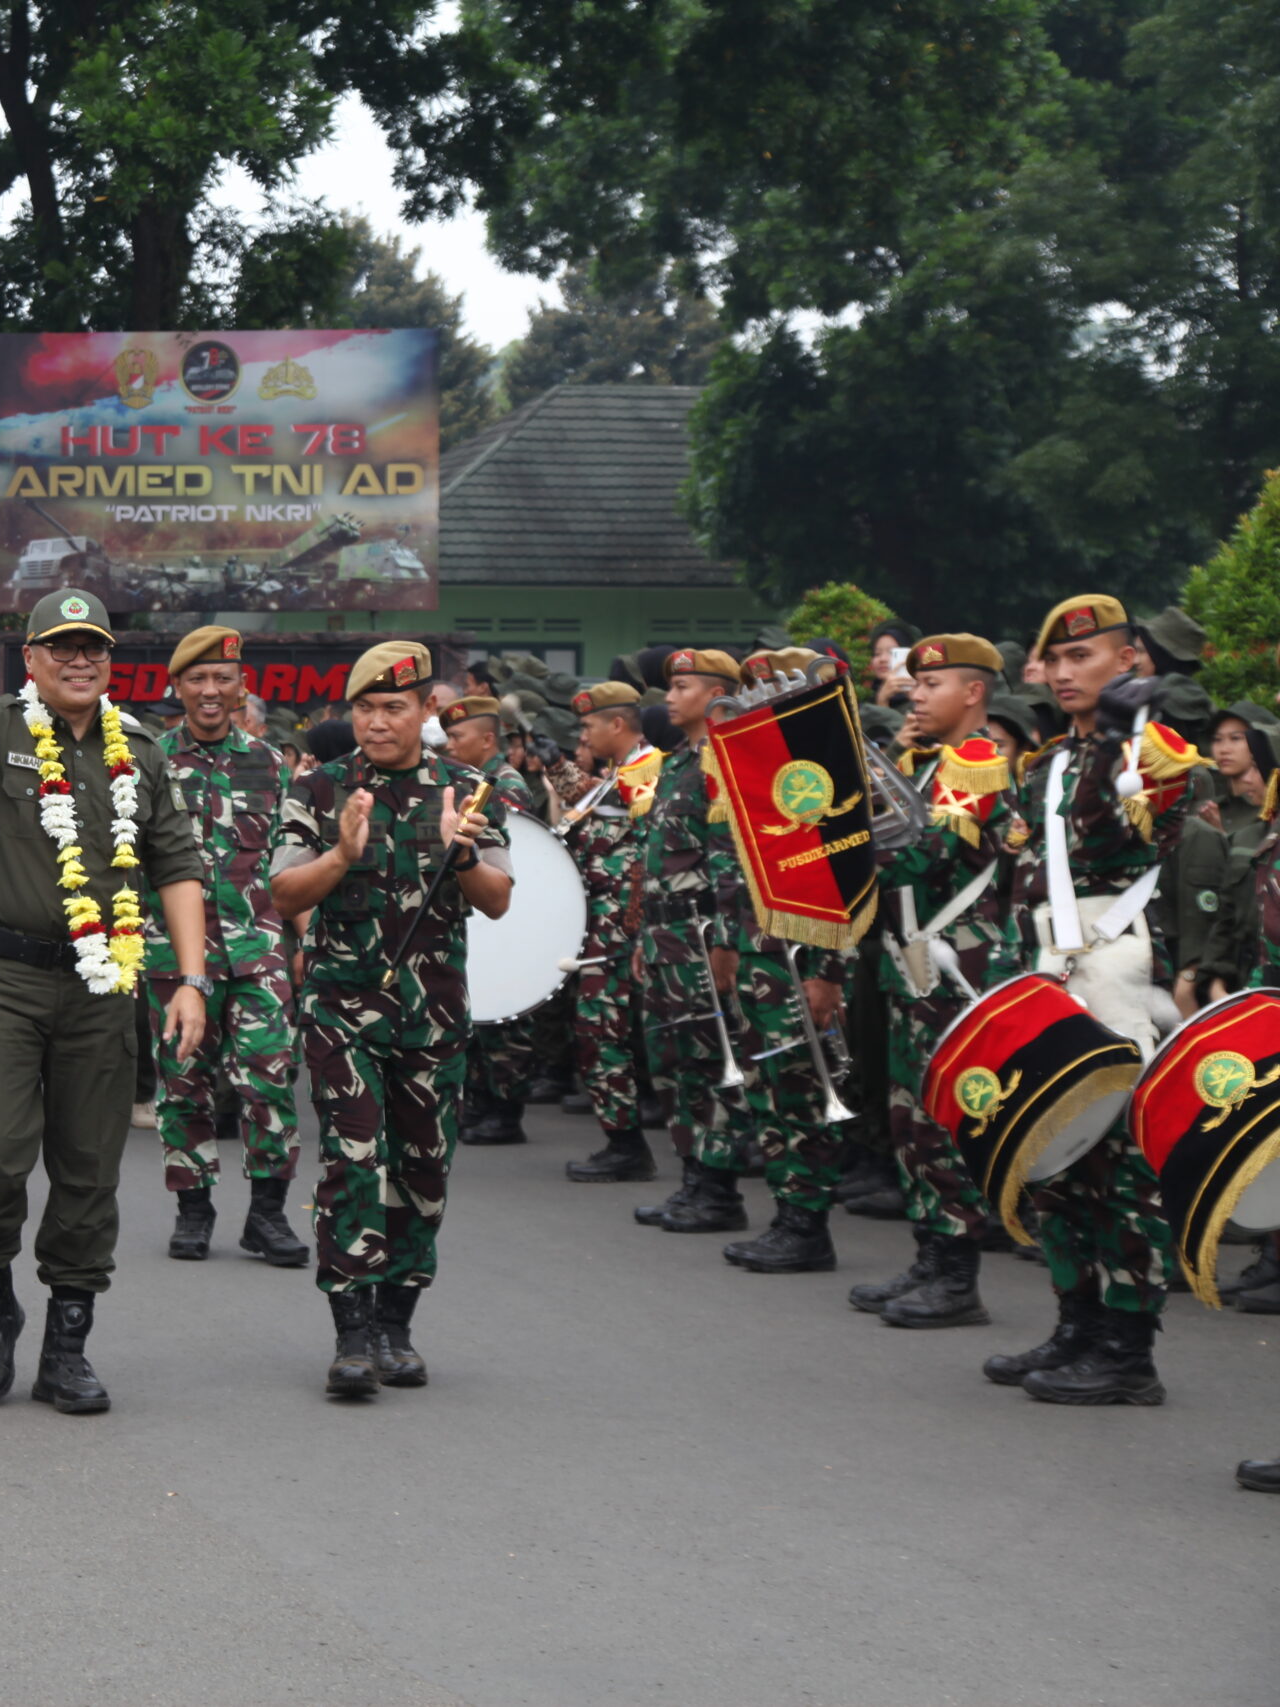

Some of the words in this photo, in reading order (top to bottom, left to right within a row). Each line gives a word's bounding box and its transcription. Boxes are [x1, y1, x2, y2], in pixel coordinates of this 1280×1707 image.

[61, 425, 182, 456] HUT
[199, 424, 274, 456] KE
[291, 424, 366, 455] 78
[6, 465, 213, 497] ARMED
[231, 464, 323, 496] TNI
[340, 464, 424, 495] AD
